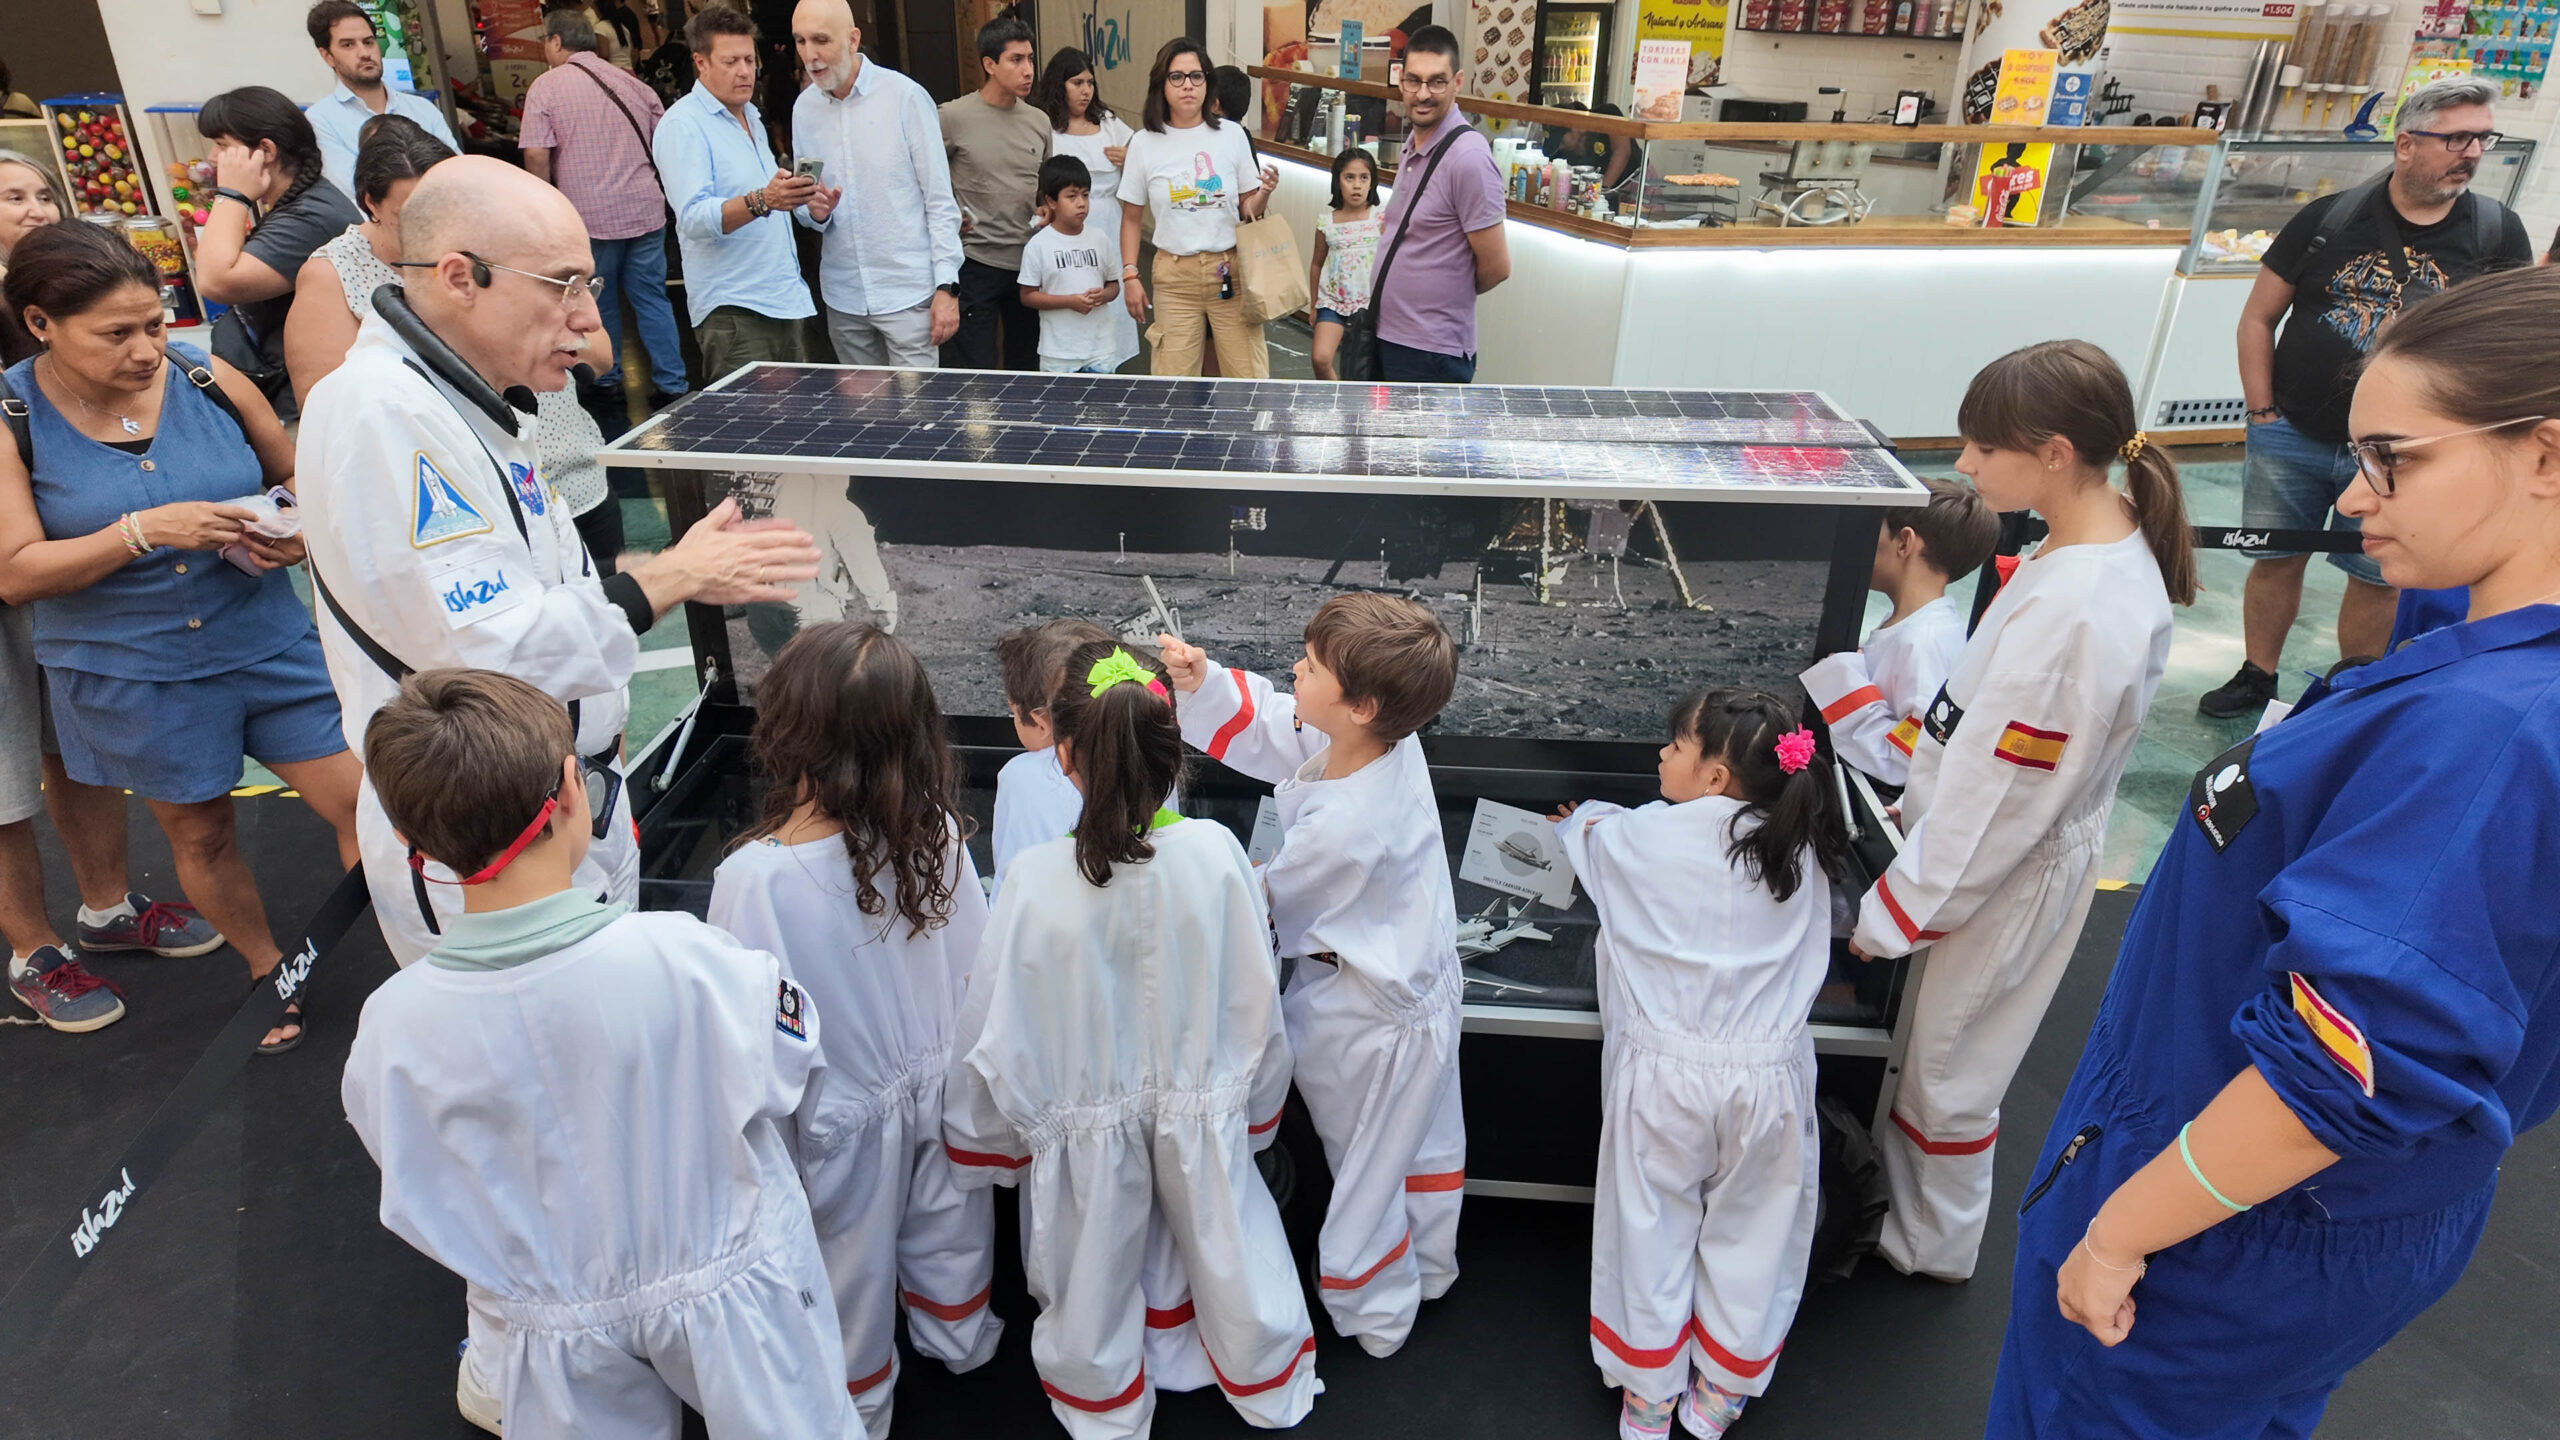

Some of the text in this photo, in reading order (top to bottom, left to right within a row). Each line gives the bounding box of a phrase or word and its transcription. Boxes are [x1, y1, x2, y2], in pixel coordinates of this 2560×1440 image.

[1643, 11, 1724, 30] Natural y Artesano
[1643, 46, 1686, 54] TORTITAS
[1641, 56, 1688, 65] CON NATA
